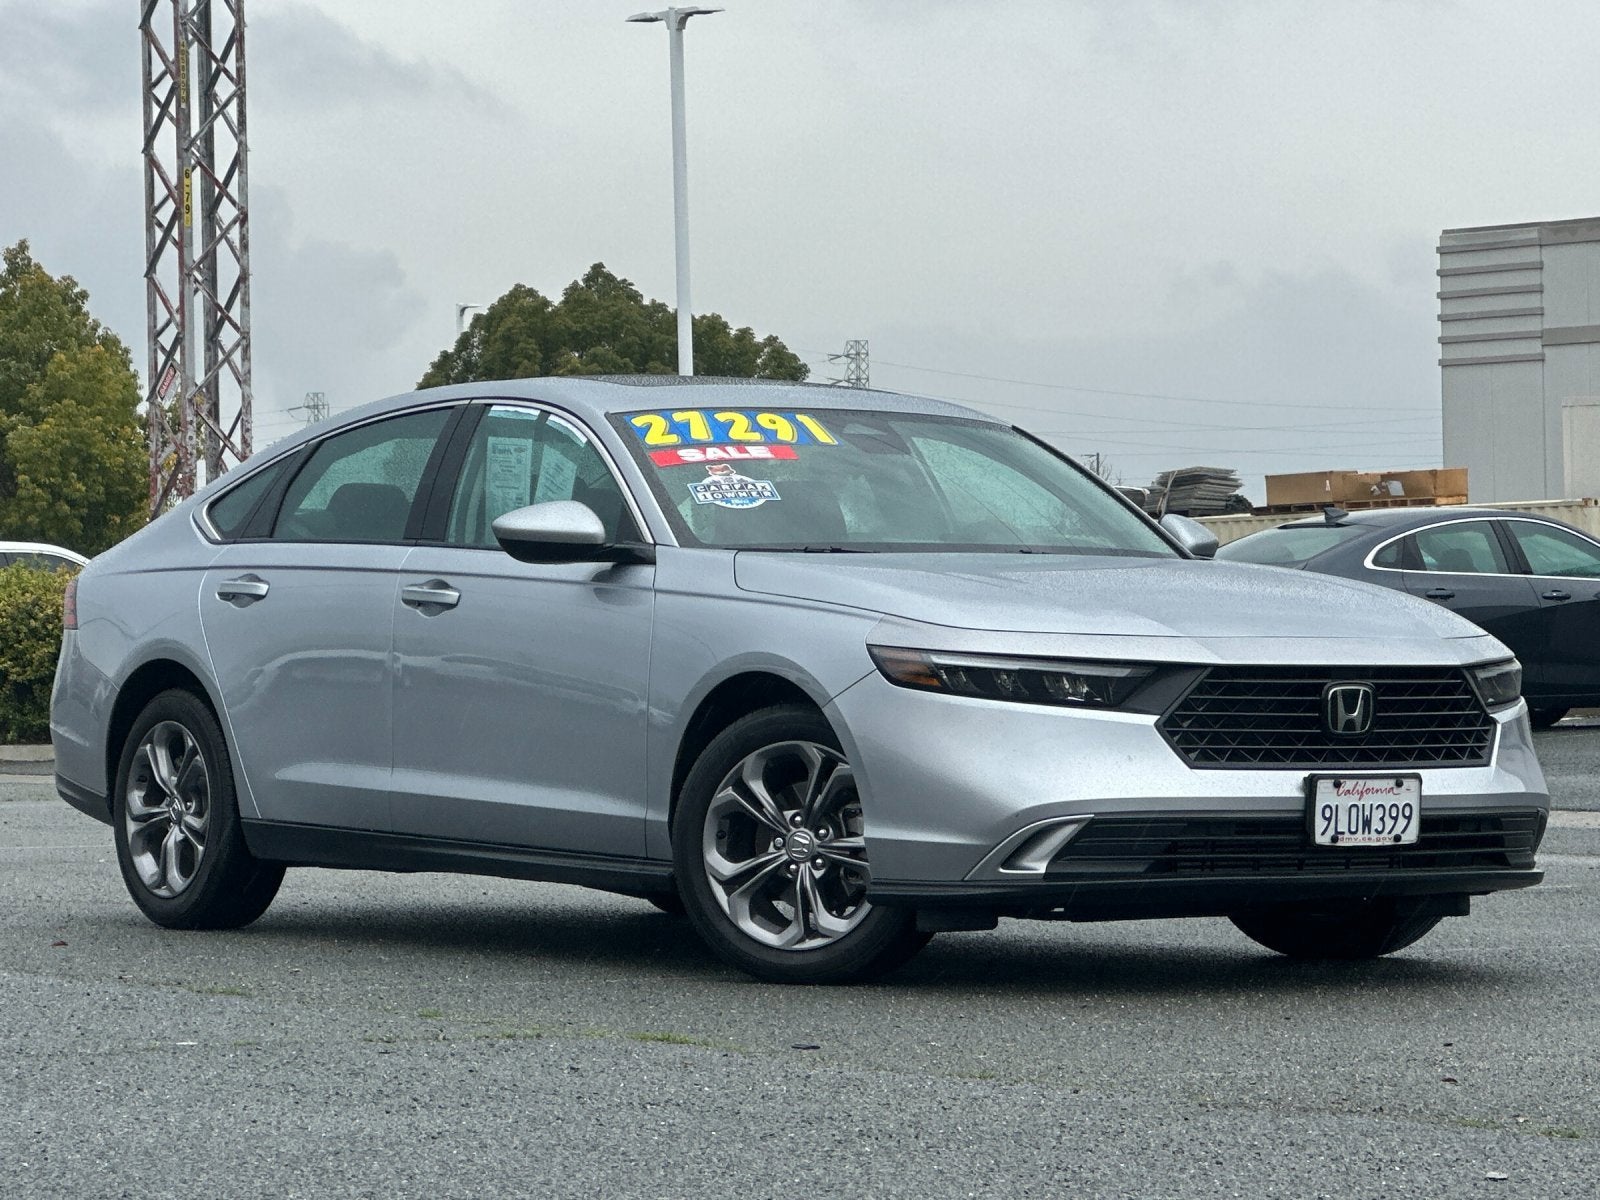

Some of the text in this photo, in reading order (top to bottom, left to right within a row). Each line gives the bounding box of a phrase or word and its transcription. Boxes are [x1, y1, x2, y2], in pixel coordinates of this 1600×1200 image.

[631, 411, 839, 445] 27291
[676, 446, 775, 462] SALE
[695, 483, 770, 493] CARFAX
[713, 491, 773, 499] OWNER
[1336, 781, 1401, 801] California
[1321, 803, 1413, 836] 9LOW399
